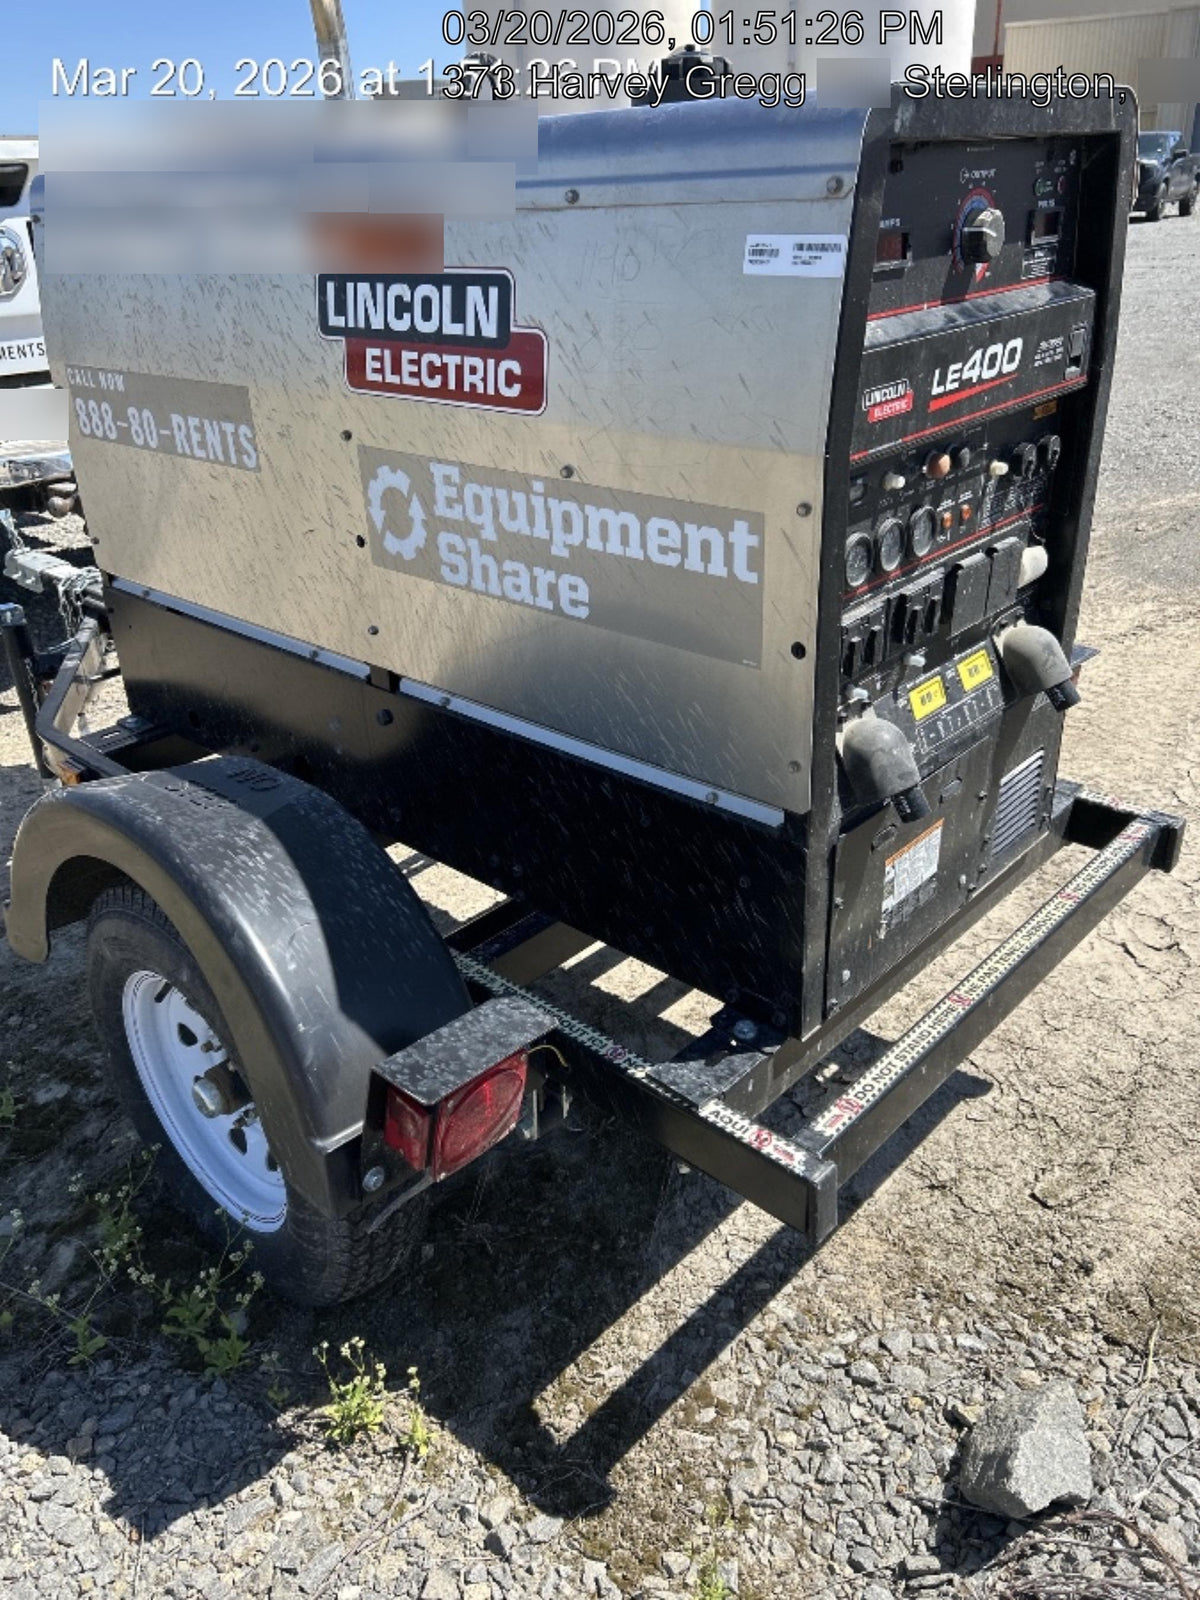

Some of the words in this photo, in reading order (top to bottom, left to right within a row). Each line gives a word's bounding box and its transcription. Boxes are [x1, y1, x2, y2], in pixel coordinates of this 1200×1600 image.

[326, 280, 499, 339] LINCOLN
[67, 367, 97, 388] CALL
[365, 347, 522, 398] ELECTRIC
[931, 337, 1023, 395] LE400
[75, 397, 257, 469] 888-80-RENTS
[429, 461, 760, 584] Equipment
[436, 530, 590, 620] Share
[853, 1083, 875, 1101] DO
[871, 1061, 898, 1083] NOT
[893, 1030, 932, 1063] STAND
[929, 1004, 958, 1031] HERE
[708, 1109, 750, 1135] AQUI
